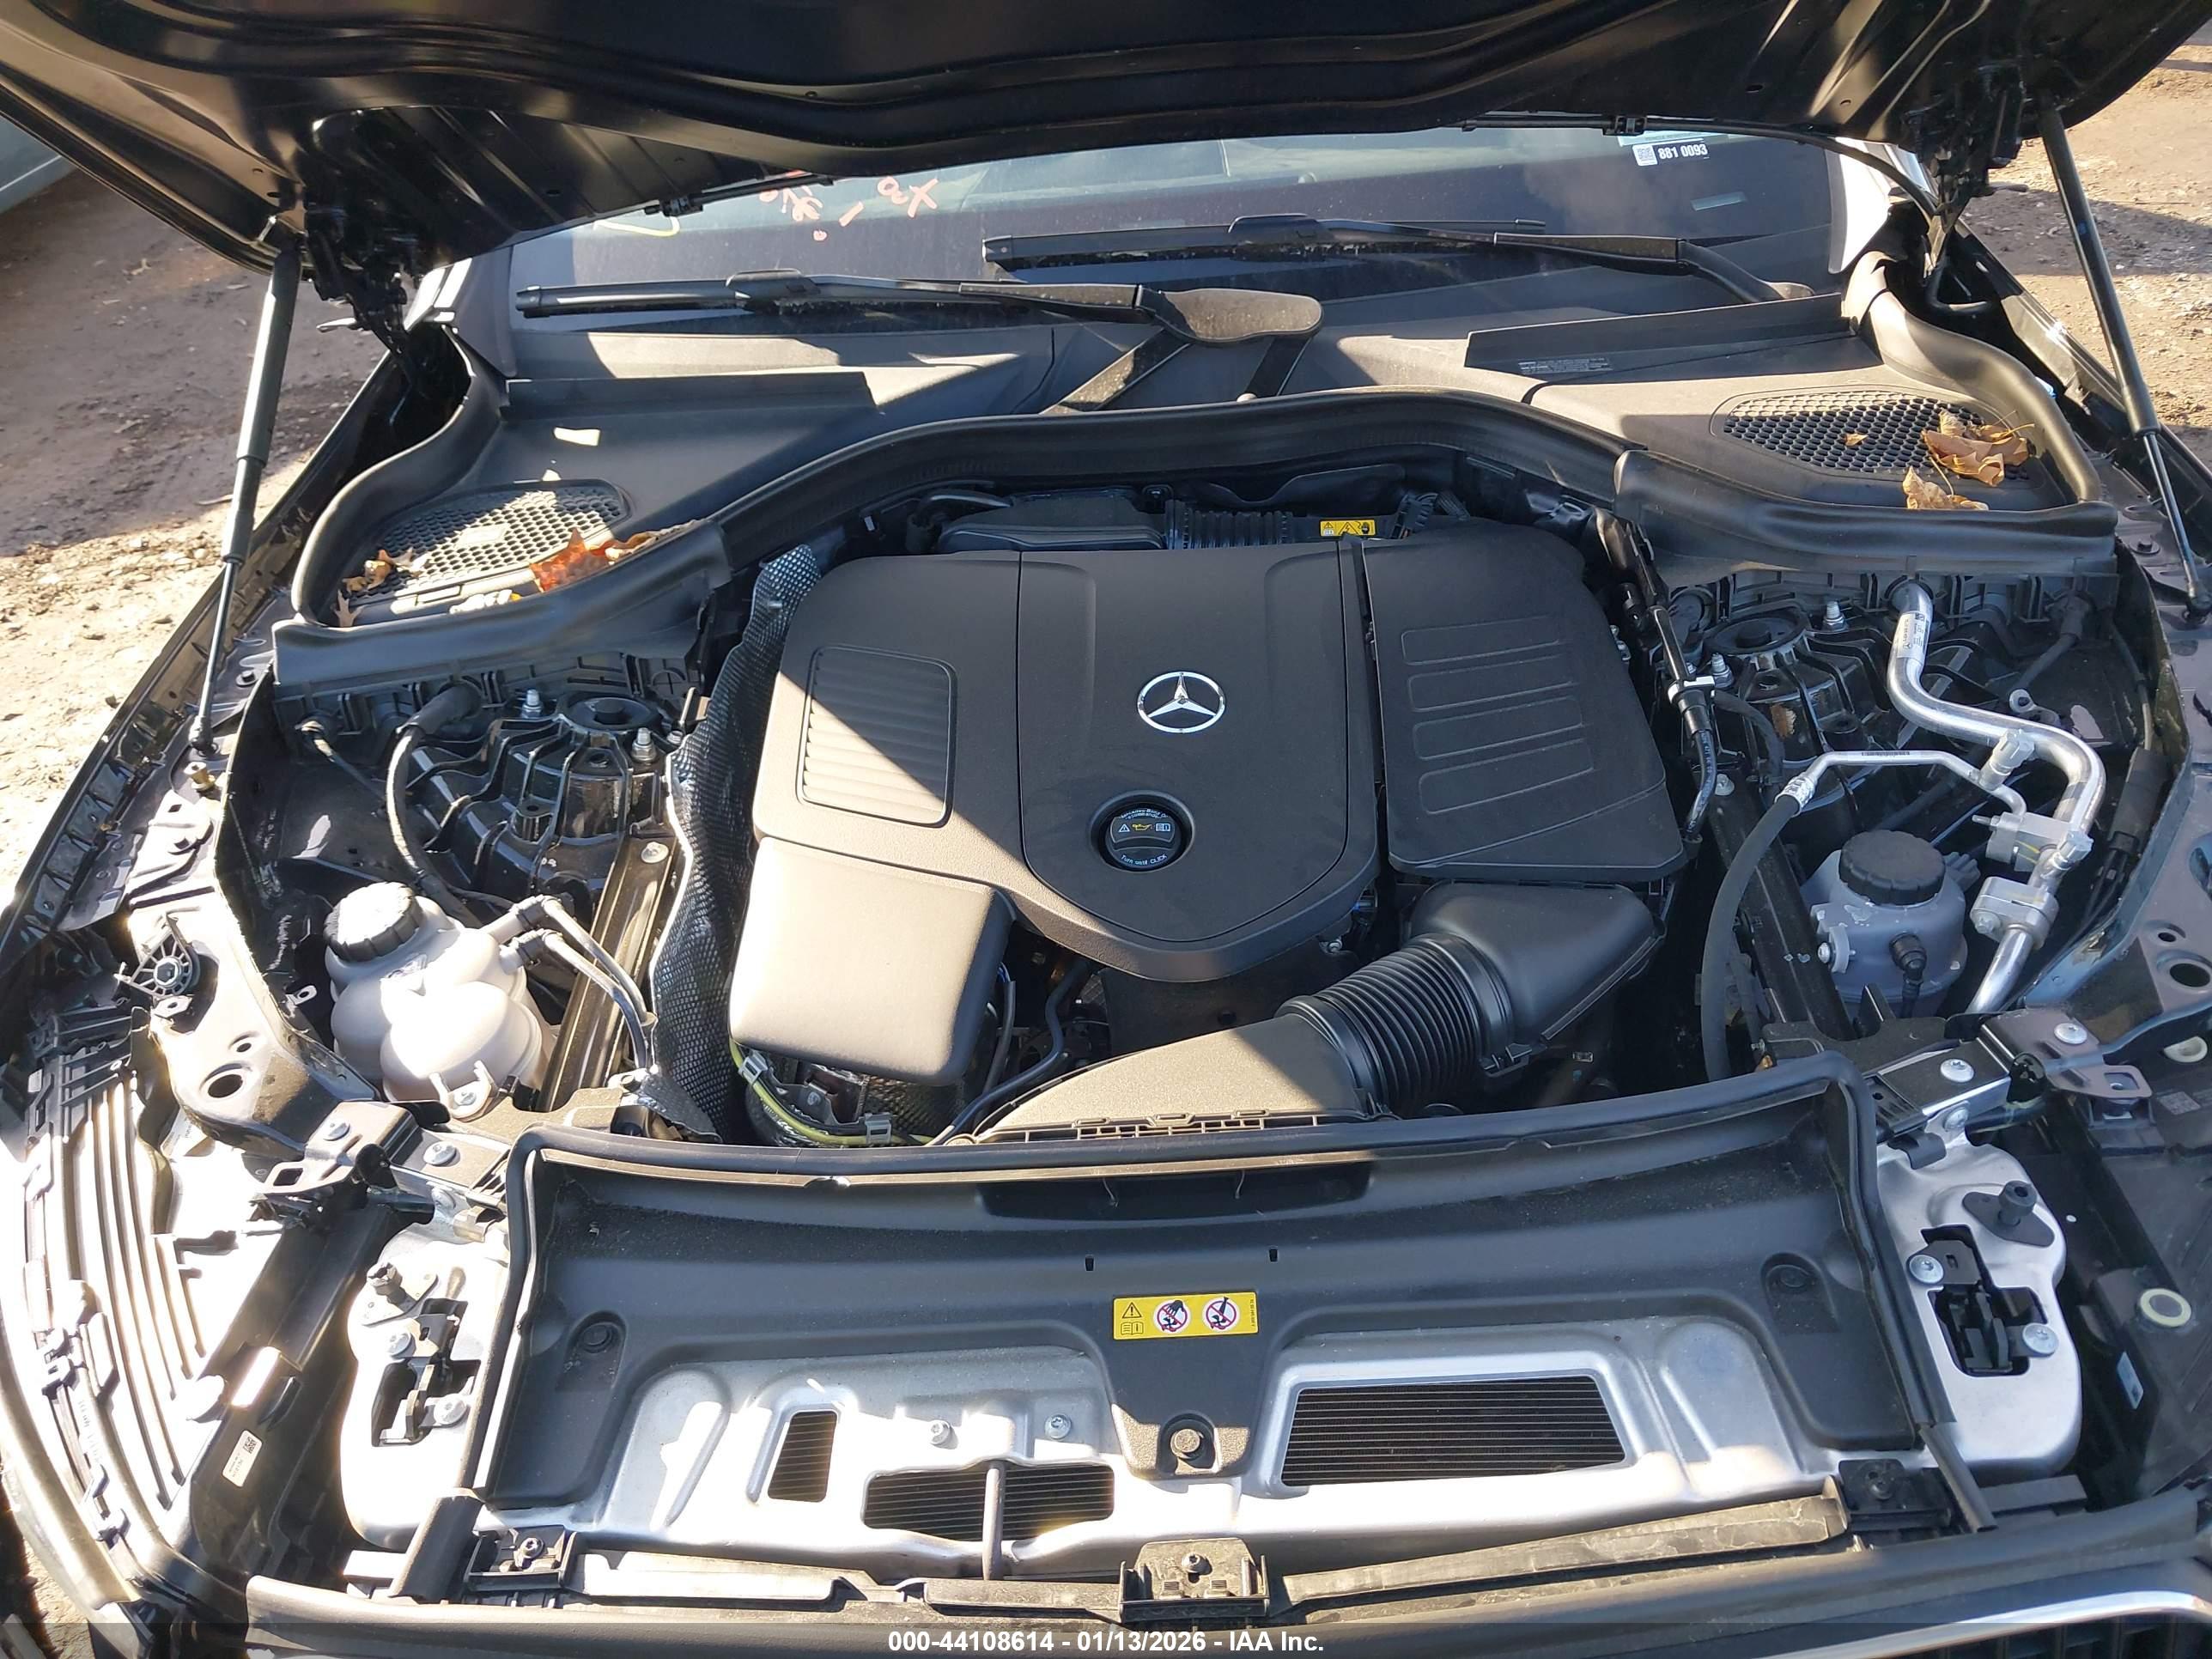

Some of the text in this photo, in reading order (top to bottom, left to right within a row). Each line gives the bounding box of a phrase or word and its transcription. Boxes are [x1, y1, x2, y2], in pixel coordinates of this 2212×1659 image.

[1657, 143, 1708, 160] 881 0093
[1121, 854, 1133, 864] Turn
[1150, 854, 1168, 864] CLICK
